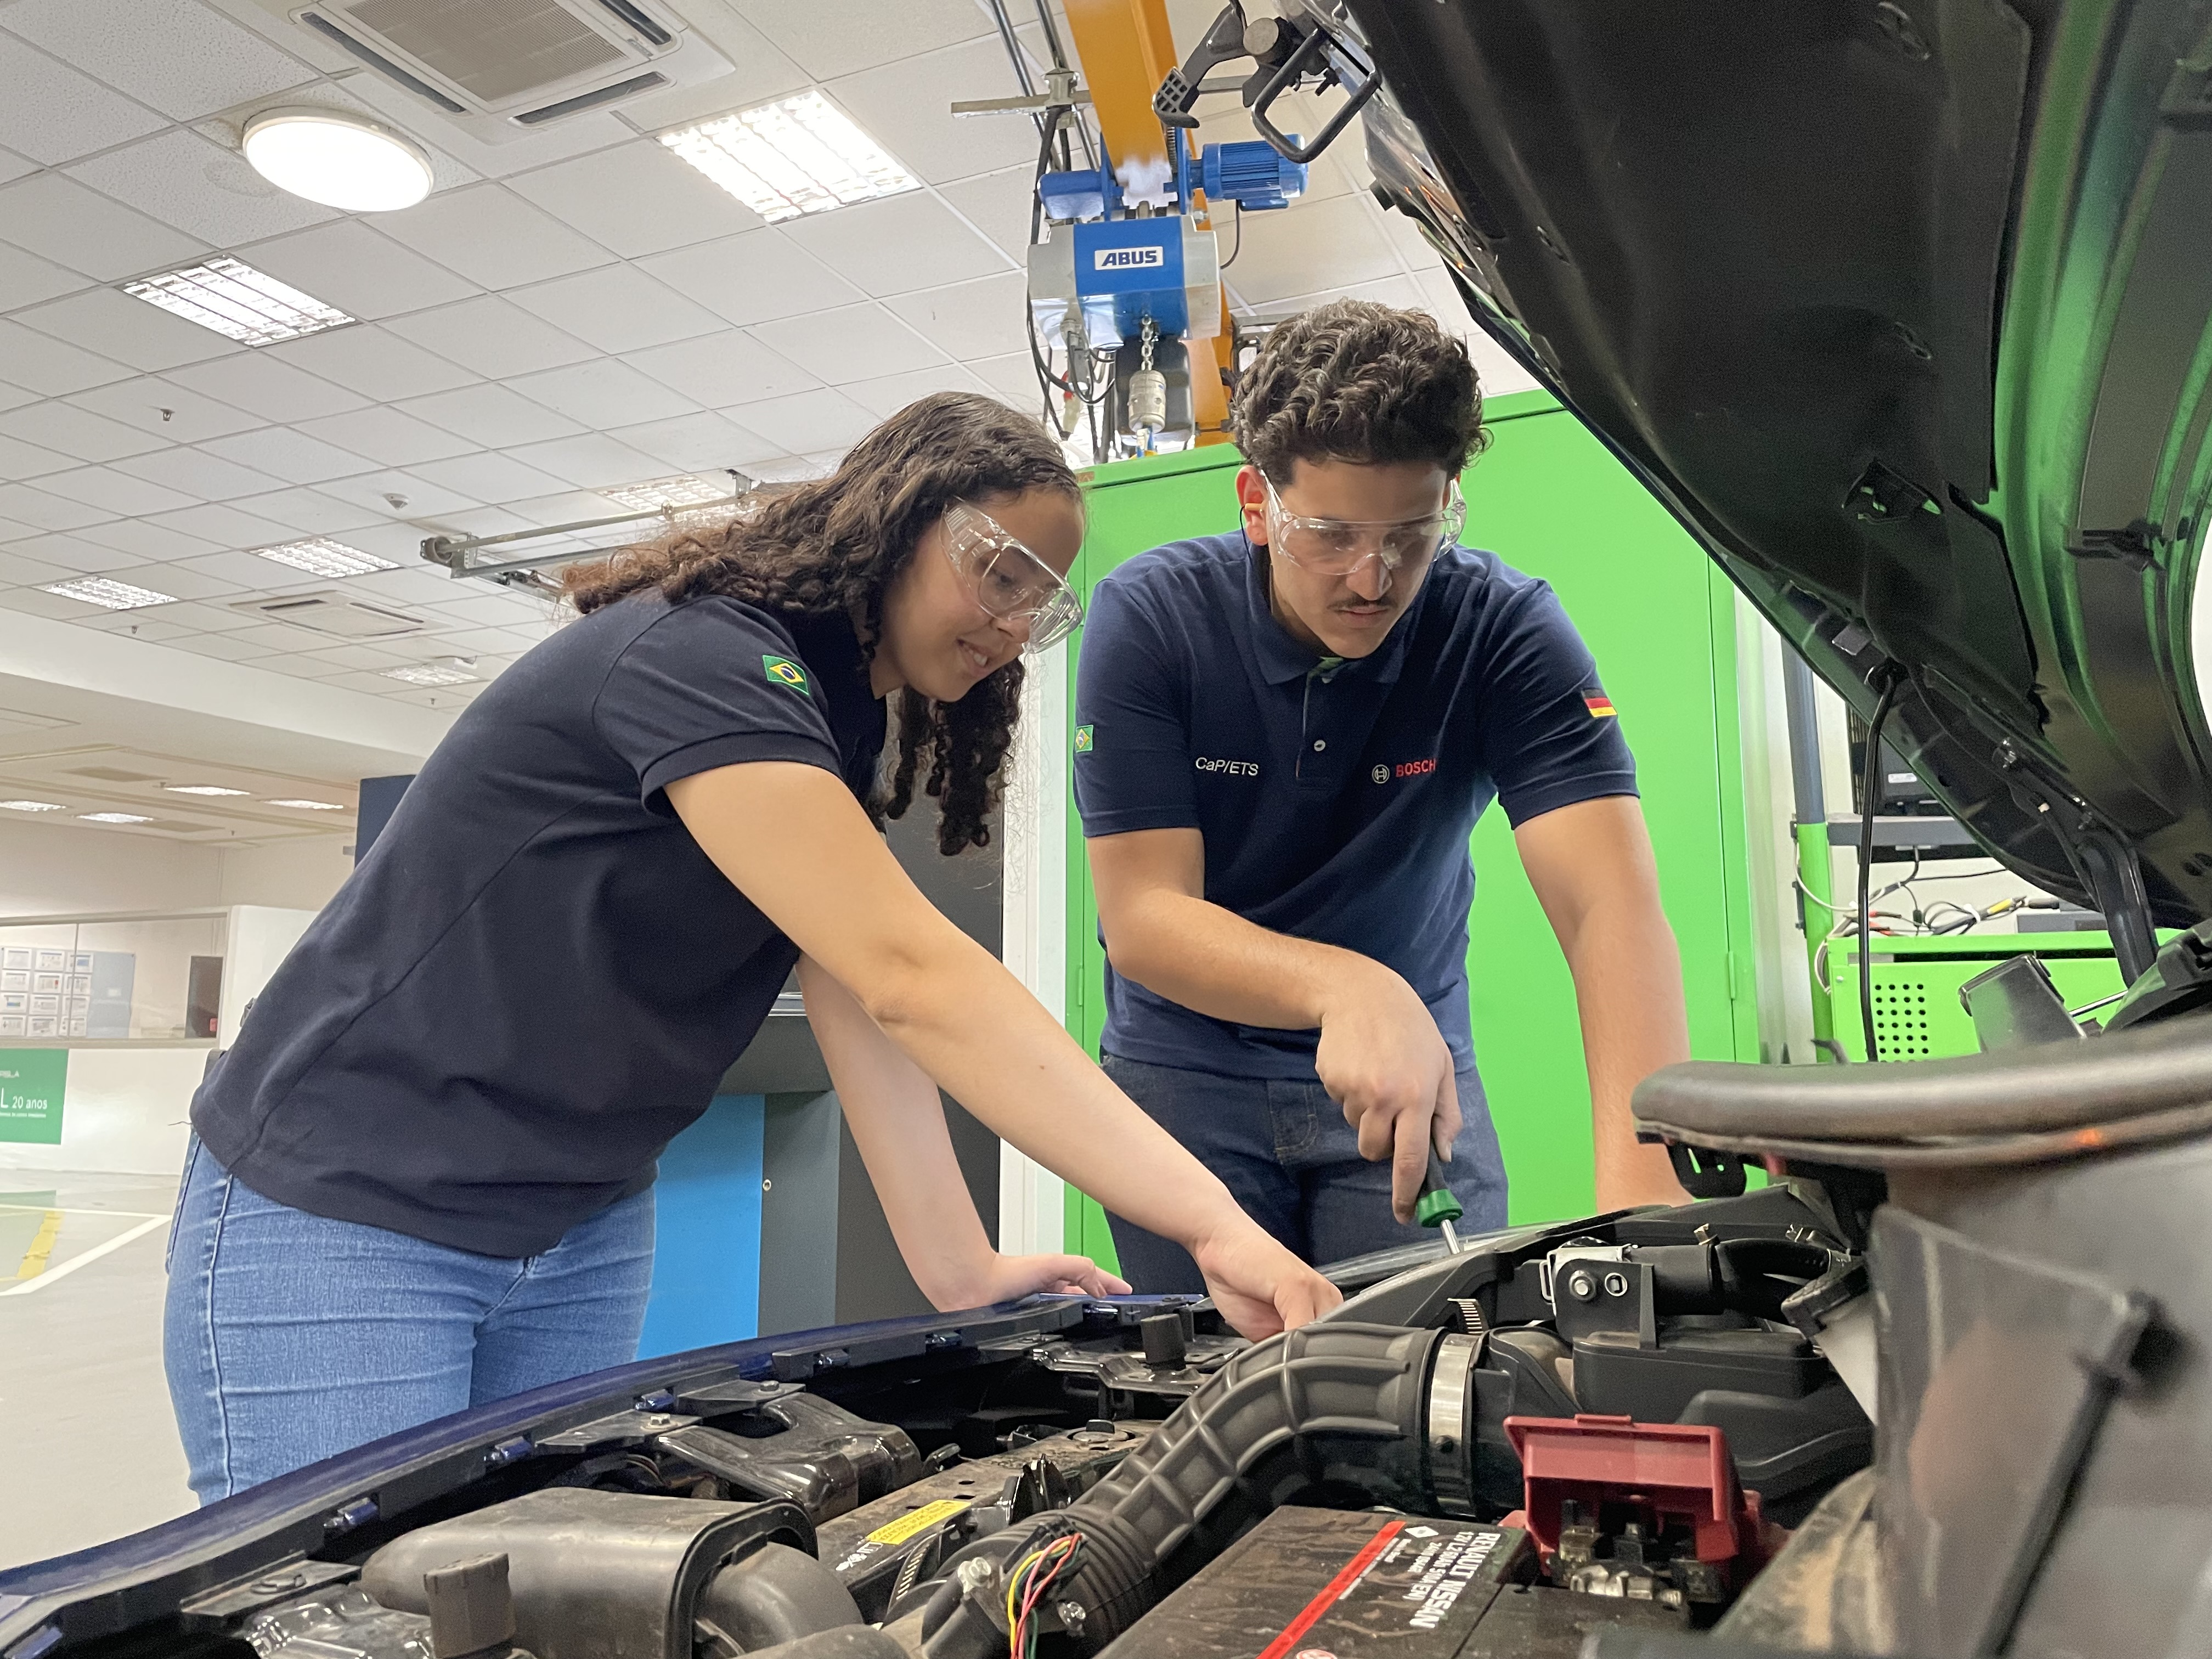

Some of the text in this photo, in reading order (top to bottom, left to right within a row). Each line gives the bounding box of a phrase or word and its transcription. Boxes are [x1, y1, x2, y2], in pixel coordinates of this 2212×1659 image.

[1101, 250, 1157, 267] ABUS
[1195, 757, 1259, 776] CaP/ETS
[1395, 758, 1436, 777] BOSCH
[12, 1096, 24, 1109] 20
[26, 1099, 48, 1109] anos
[1453, 1531, 1474, 1543] 12V
[1446, 1542, 1466, 1551] L2
[1409, 1532, 1502, 1629] RENAULT NISSAN
